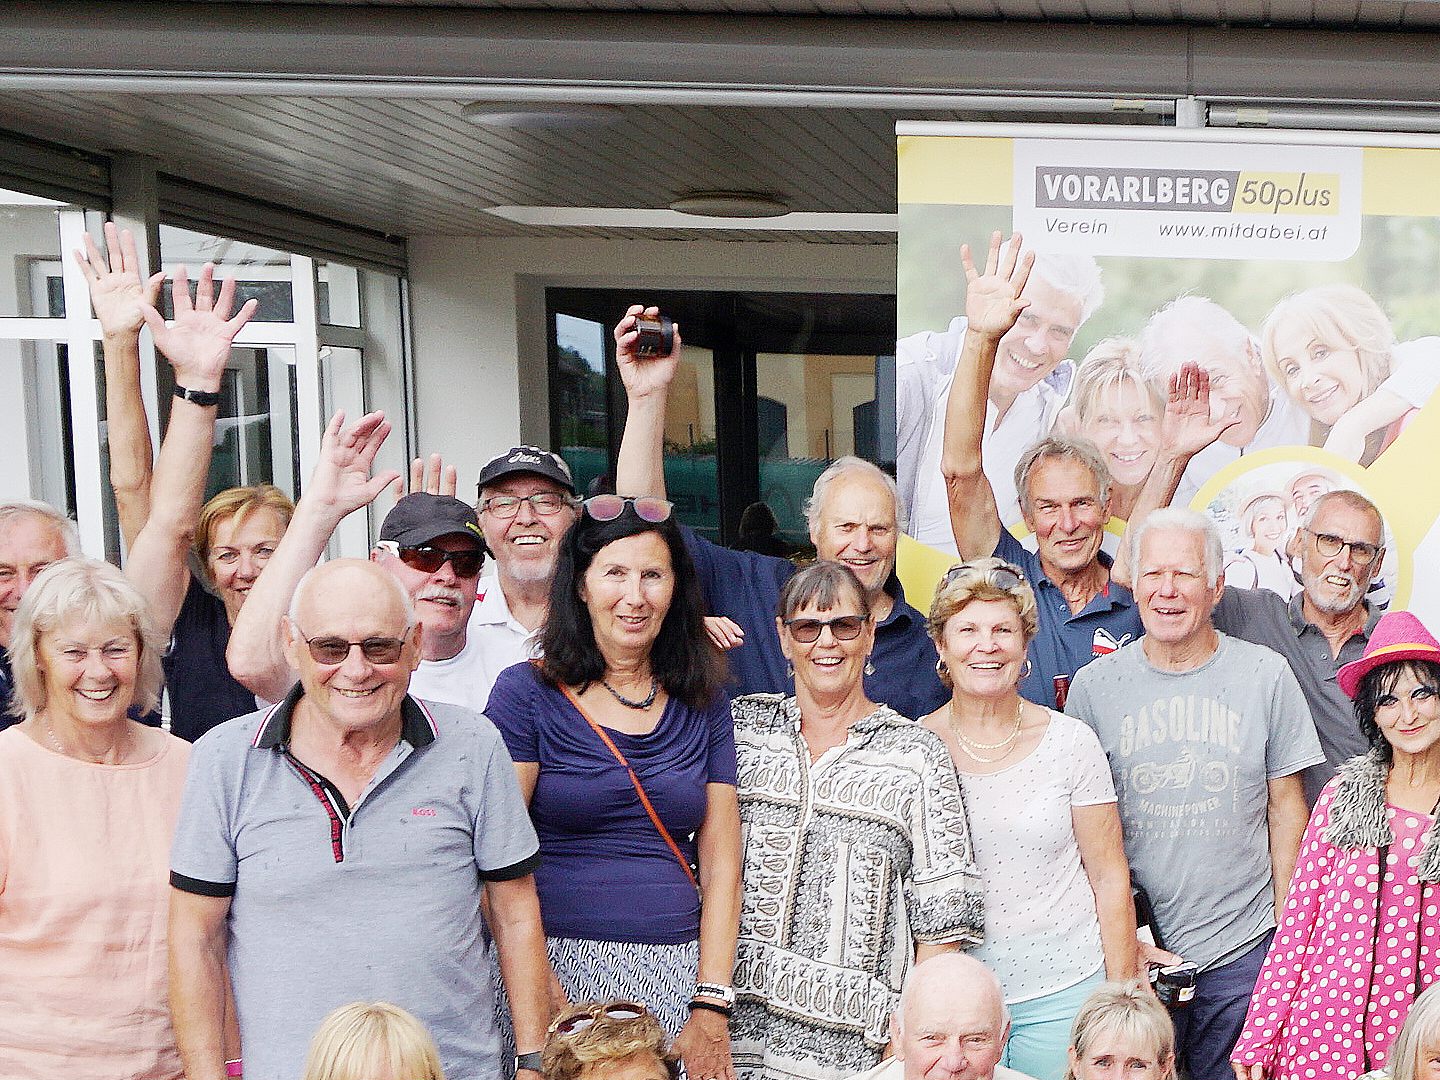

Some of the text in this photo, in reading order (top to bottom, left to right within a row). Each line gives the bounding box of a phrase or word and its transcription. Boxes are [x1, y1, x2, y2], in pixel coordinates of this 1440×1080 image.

[1042, 173, 1331, 214] VORARLBERG 50plus
[1045, 218, 1328, 241] Verein www.mitdabei.at
[1119, 694, 1242, 757] GASOLINE
